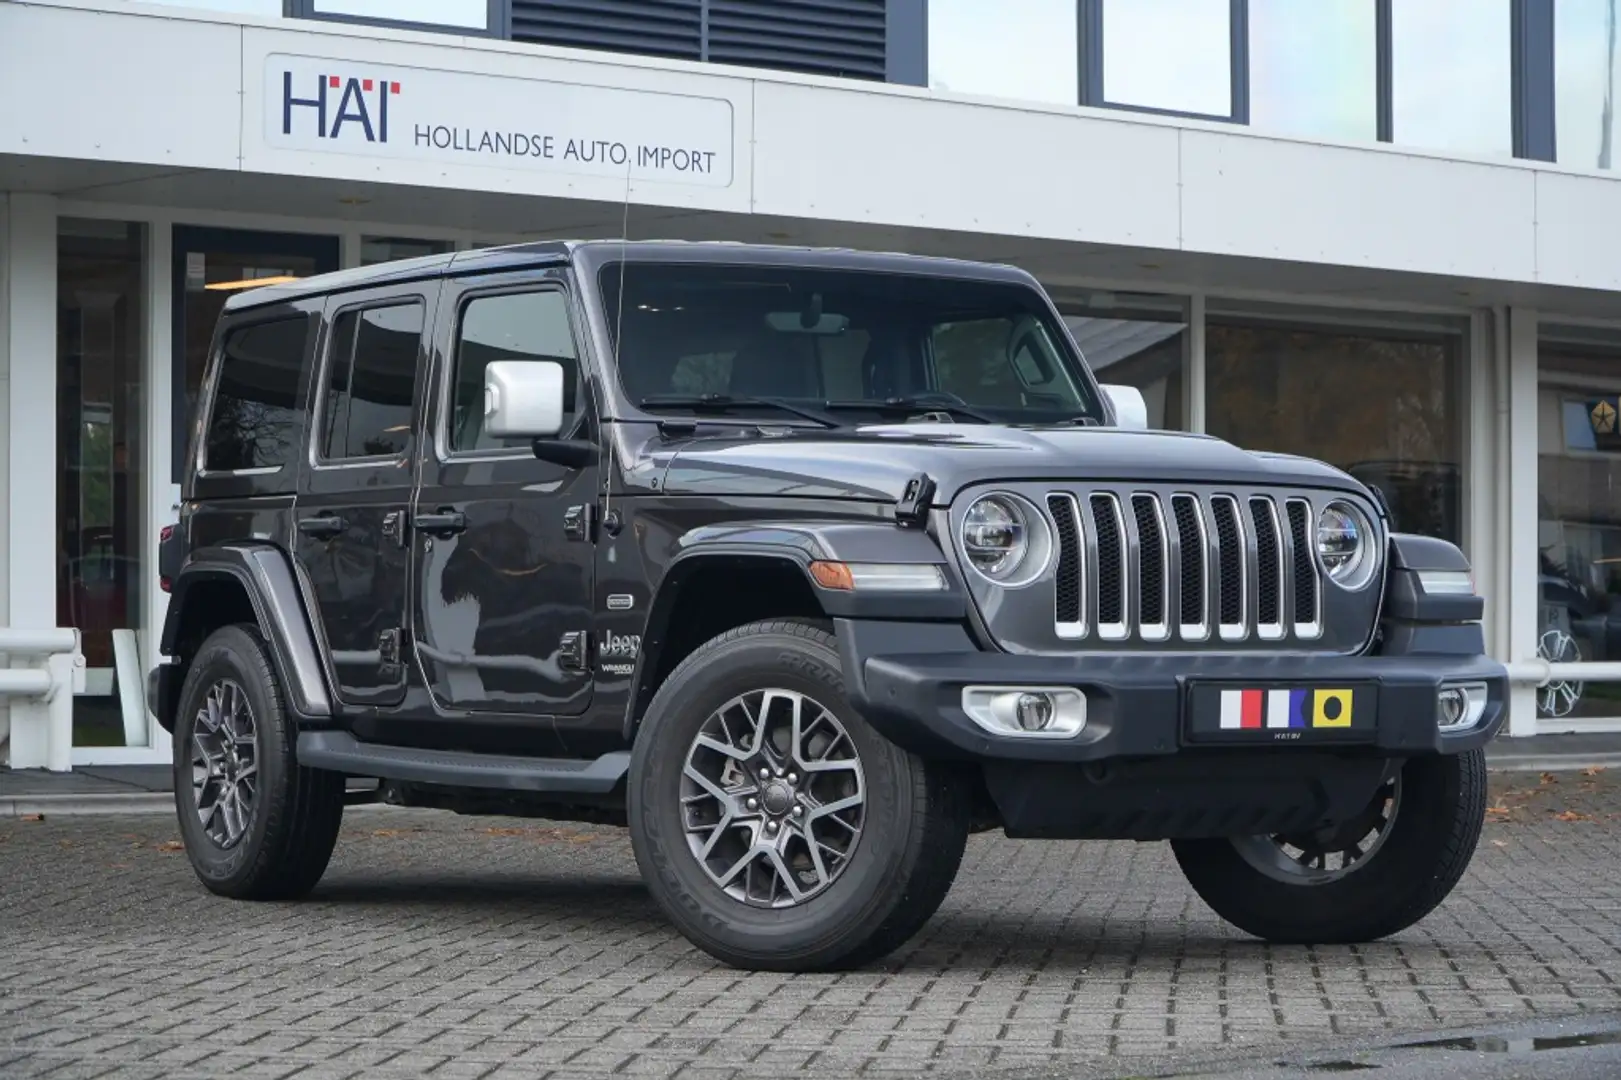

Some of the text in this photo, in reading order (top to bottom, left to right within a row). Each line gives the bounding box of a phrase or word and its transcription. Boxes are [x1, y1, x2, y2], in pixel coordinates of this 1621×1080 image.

[414, 123, 716, 173] HOLLANDSE AUTO IMPORT
[600, 629, 641, 659] Jeep
